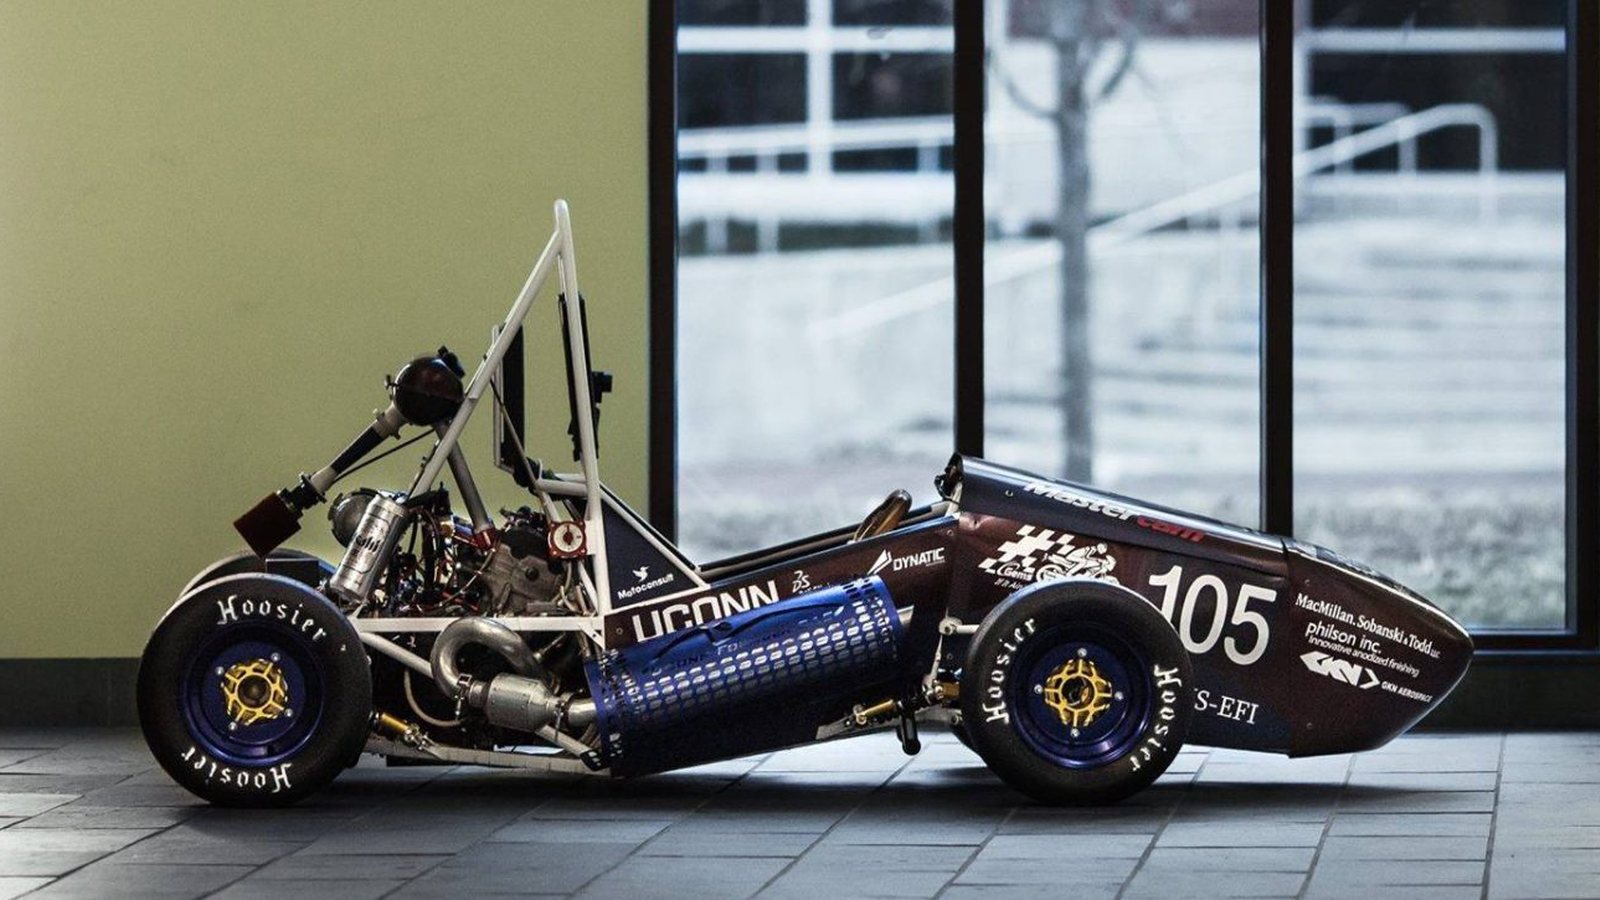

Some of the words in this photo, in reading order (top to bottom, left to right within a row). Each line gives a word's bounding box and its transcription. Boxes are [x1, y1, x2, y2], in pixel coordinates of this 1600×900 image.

[893, 547, 945, 571] DYNATIC
[617, 573, 674, 599] Motoconsult
[217, 595, 327, 641] Hoosier
[632, 580, 779, 642] UCONN
[1148, 564, 1277, 665] 105
[1305, 621, 1357, 646] philson
[1360, 634, 1382, 654] inc.
[1357, 614, 1404, 644] Sobanski
[1409, 633, 1433, 655] Todd
[982, 617, 1036, 725] Hoosier
[1130, 664, 1182, 772] Hoosier
[1192, 687, 1259, 725] S-EFI
[181, 747, 293, 793] Hoosier
